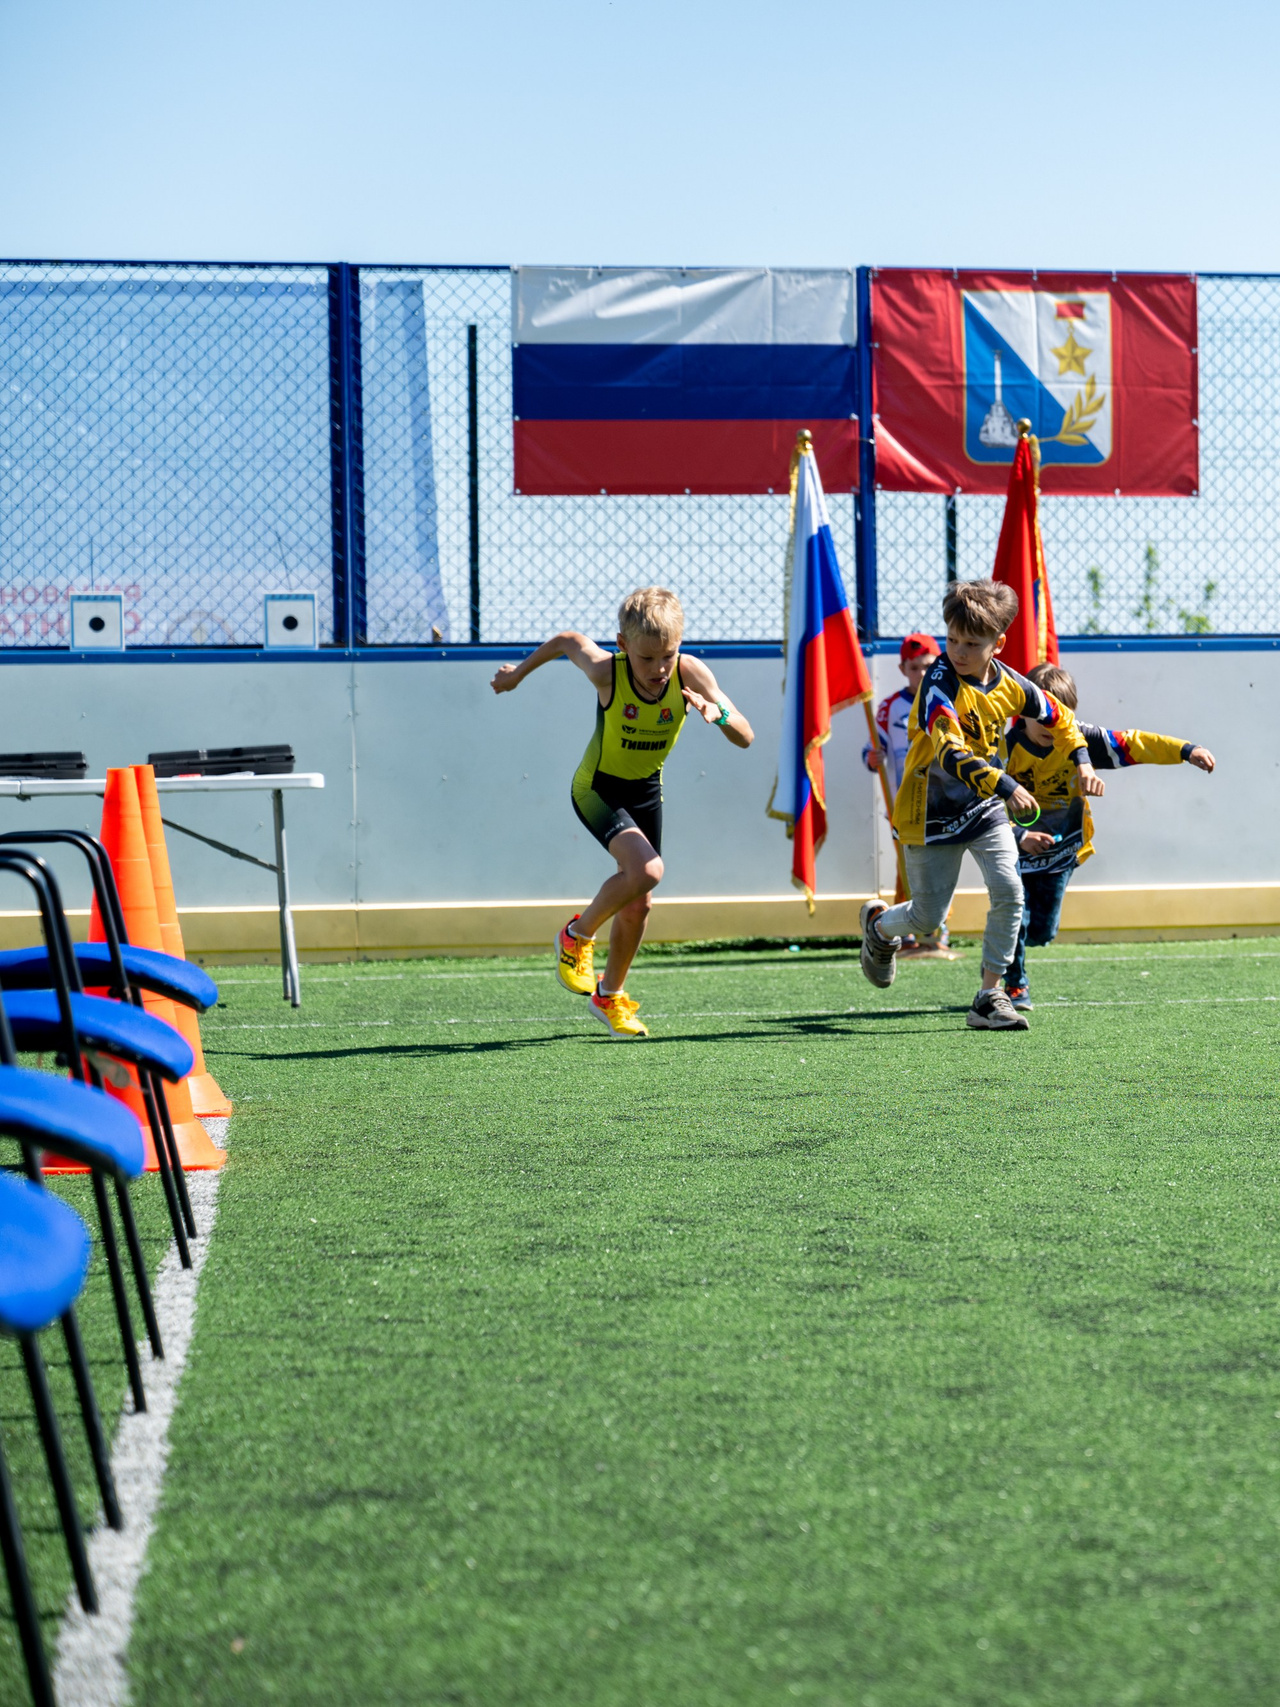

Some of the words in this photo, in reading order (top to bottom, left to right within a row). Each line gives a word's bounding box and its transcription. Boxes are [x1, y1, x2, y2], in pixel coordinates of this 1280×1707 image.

[0, 585, 140, 604] НОВЯ
[621, 738, 667, 751] ТИШИН
[960, 815, 966, 824] &
[1040, 858, 1046, 866] &
